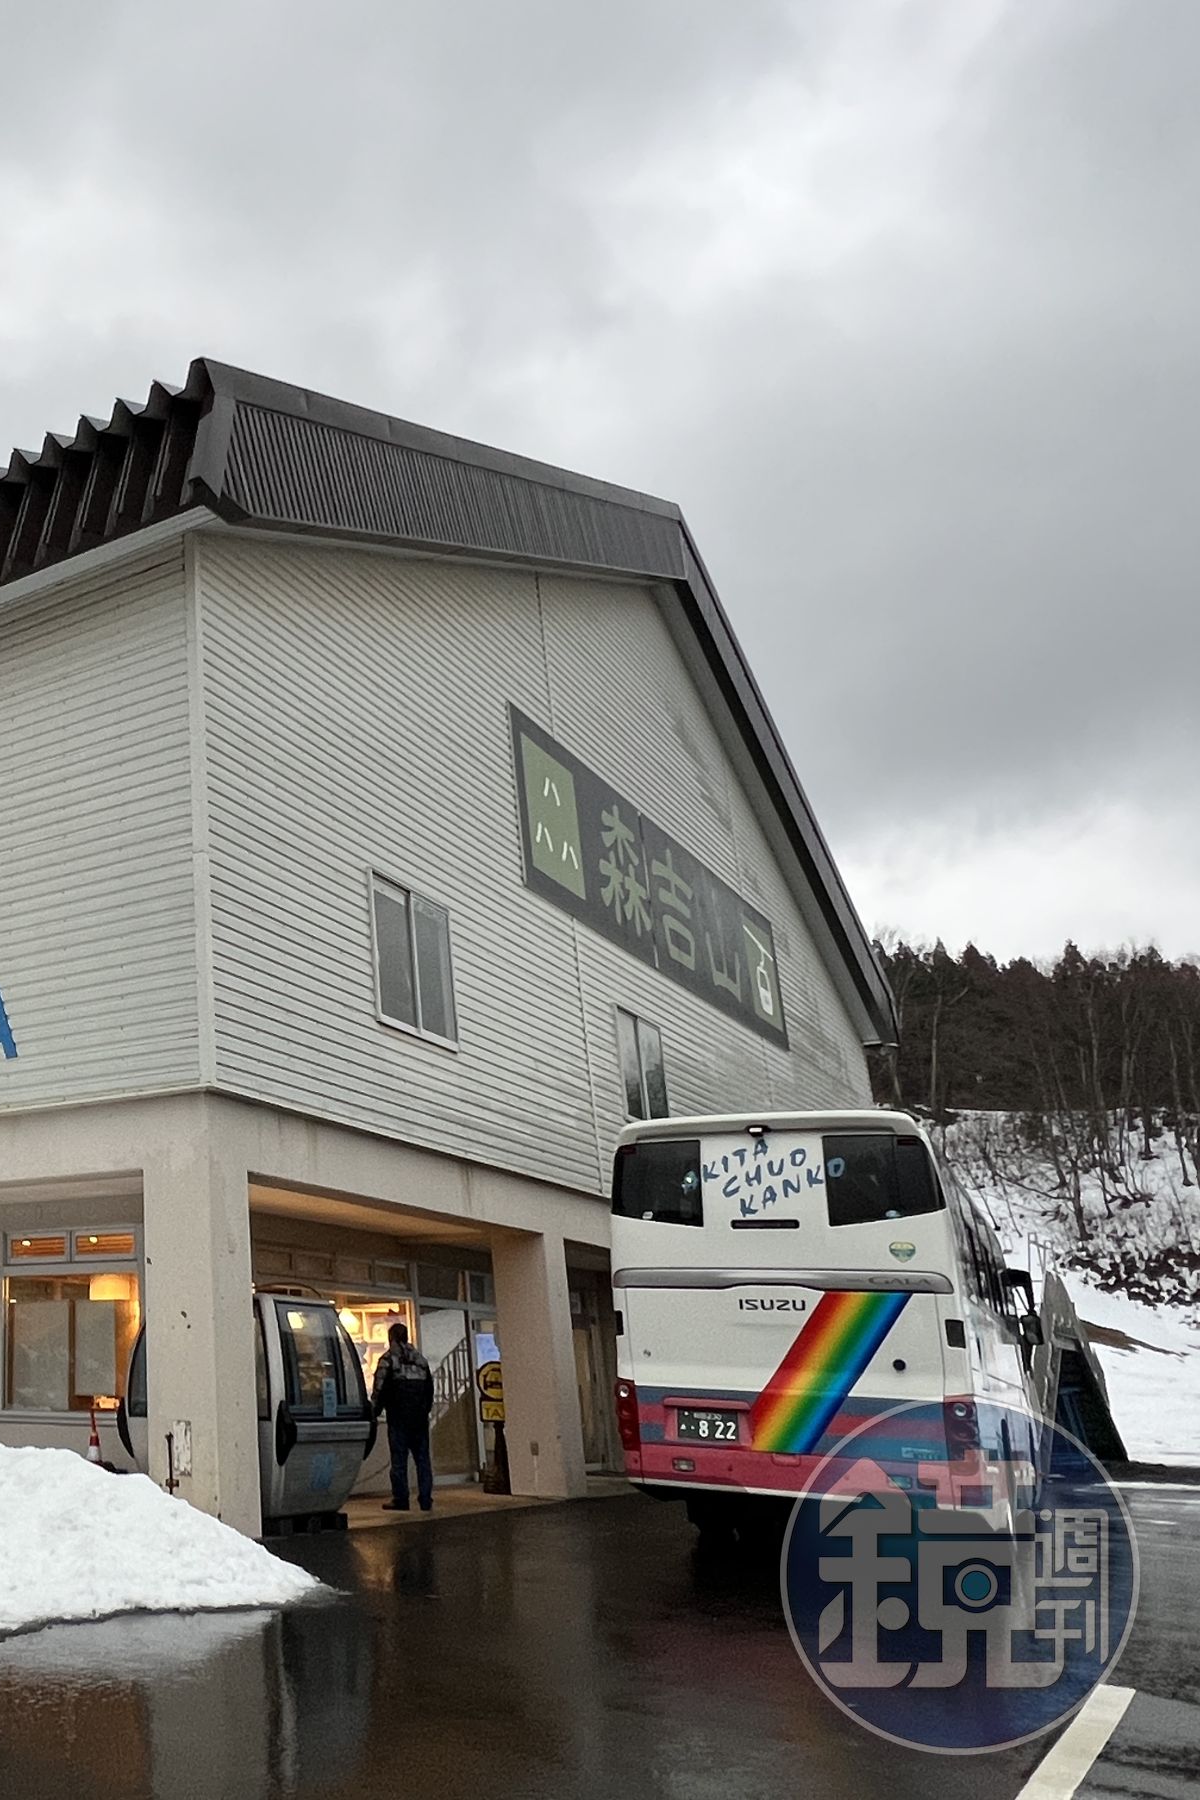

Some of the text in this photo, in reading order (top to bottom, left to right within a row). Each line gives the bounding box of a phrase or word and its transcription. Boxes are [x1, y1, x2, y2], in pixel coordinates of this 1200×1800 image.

[600, 805, 742, 1003] 森吉山
[722, 1148, 806, 1198] CHUO
[739, 1157, 845, 1218] KANKO
[739, 1299, 806, 1311] ISUZU
